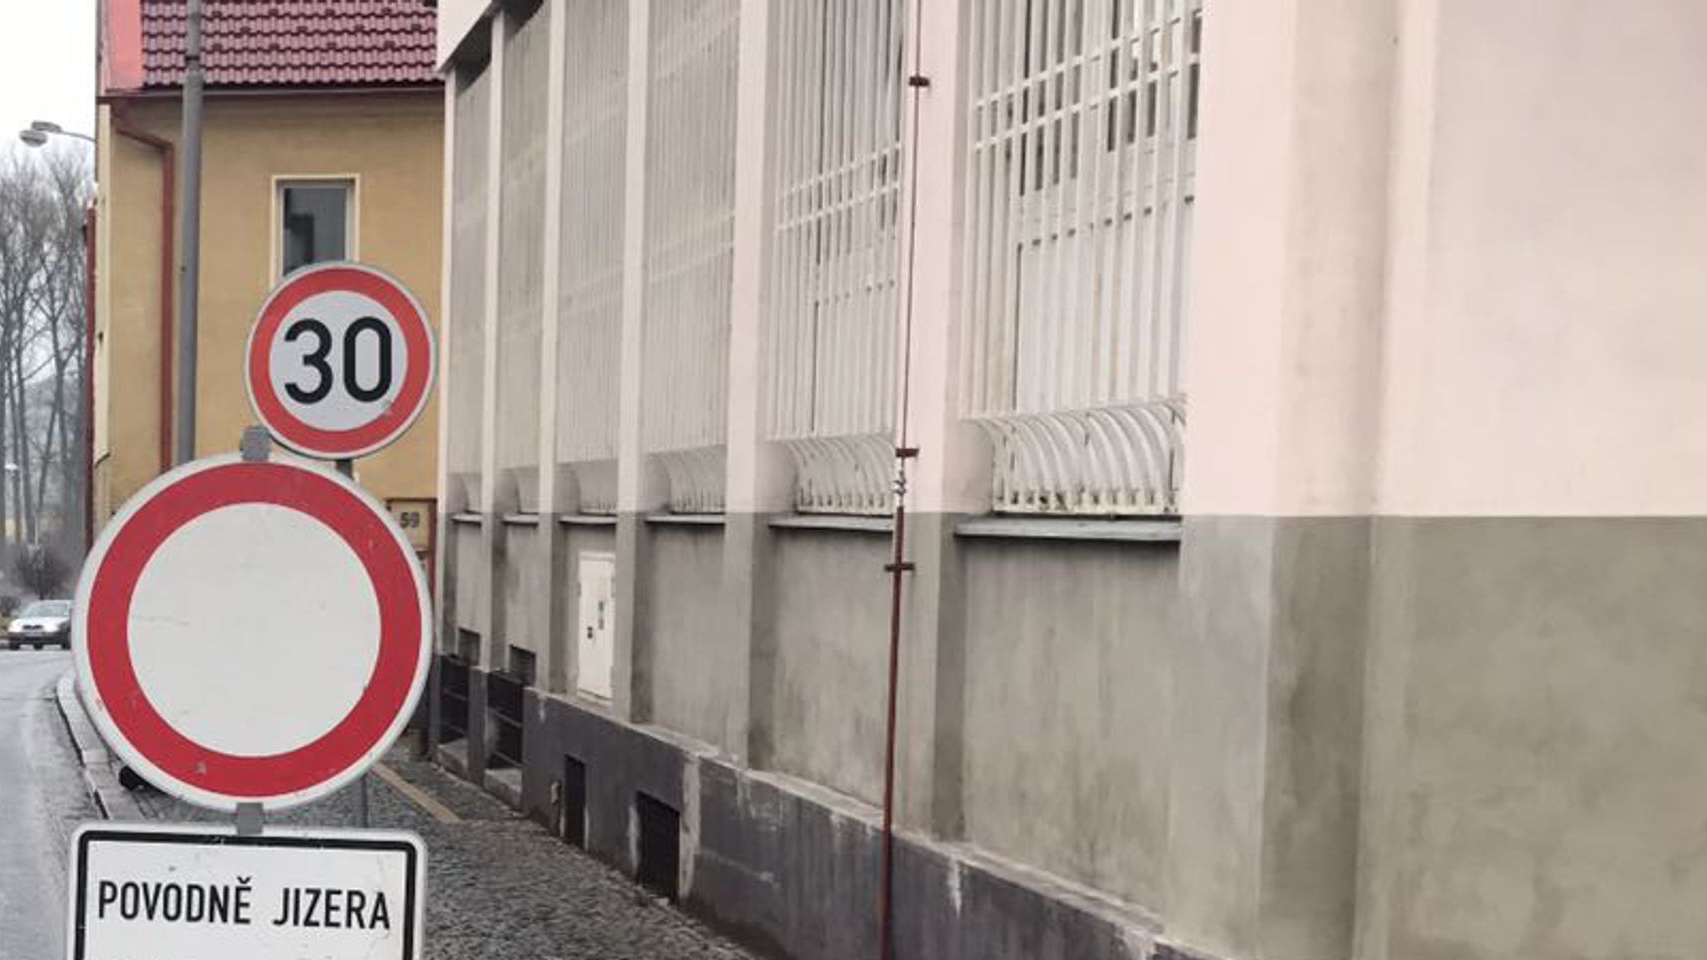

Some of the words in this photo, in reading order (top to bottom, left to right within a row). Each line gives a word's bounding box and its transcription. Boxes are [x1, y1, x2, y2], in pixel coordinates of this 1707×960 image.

[284, 316, 392, 404] 30
[97, 876, 252, 925] POVODNĚ
[272, 887, 391, 930] JIZERA
